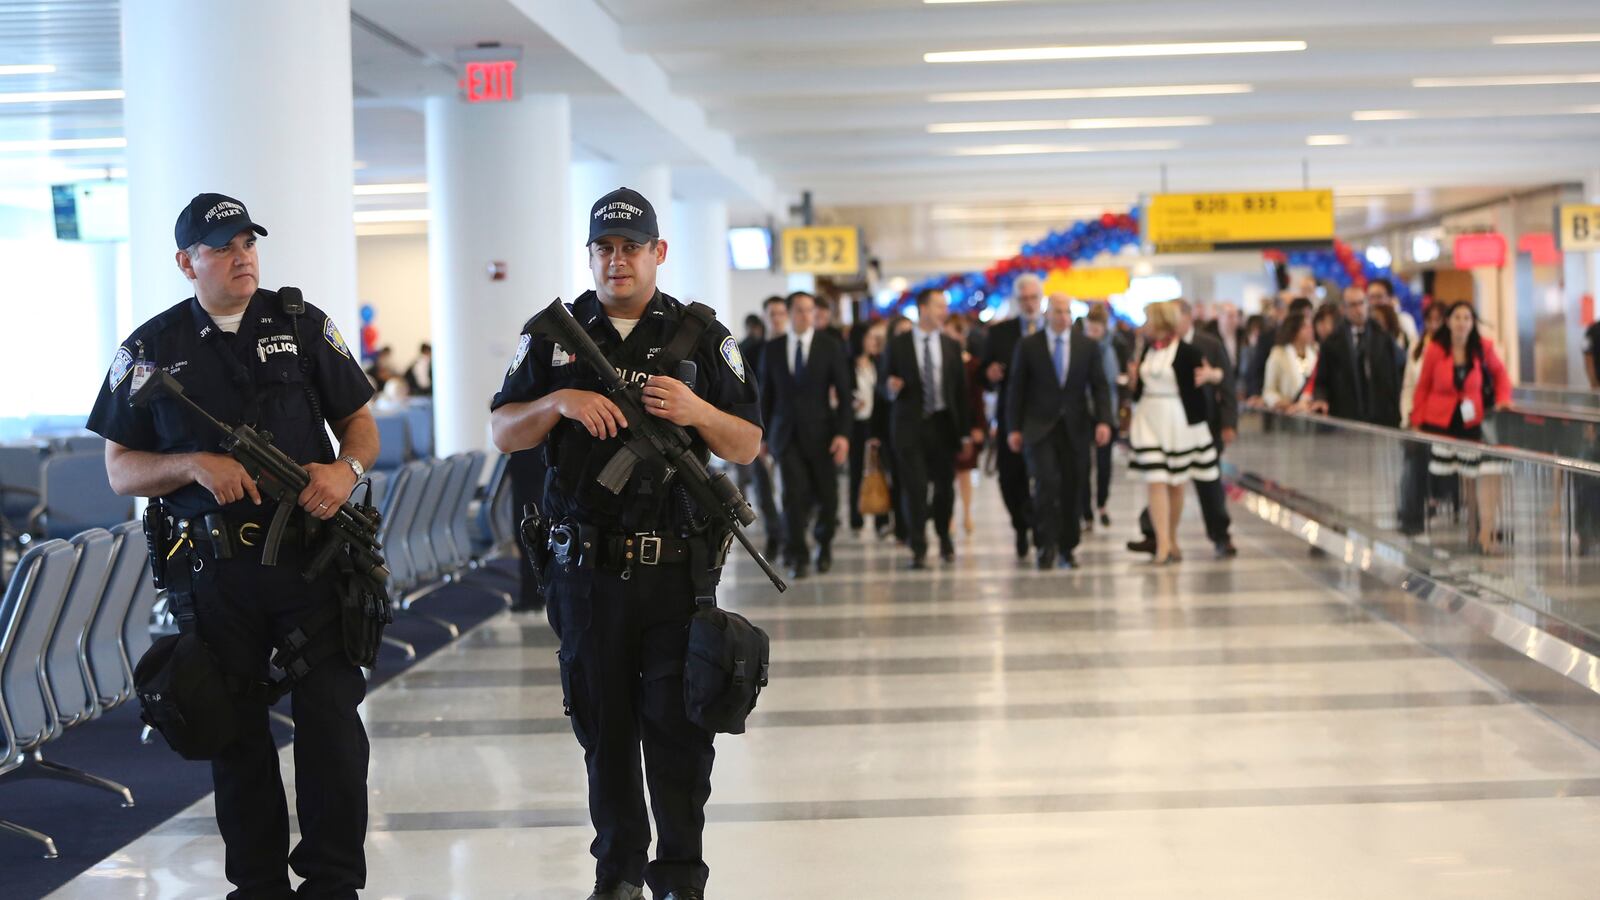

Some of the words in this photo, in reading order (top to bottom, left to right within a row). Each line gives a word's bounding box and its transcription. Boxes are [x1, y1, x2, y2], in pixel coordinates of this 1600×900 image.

[466, 61, 517, 101] EXIT
[205, 206, 219, 223] PORT
[216, 208, 241, 220] POLICE
[594, 205, 608, 219] PORT
[608, 201, 643, 217] AUTHORITY
[603, 211, 632, 220] POLICE
[791, 236, 846, 264] B32
[200, 325, 212, 338] JFK
